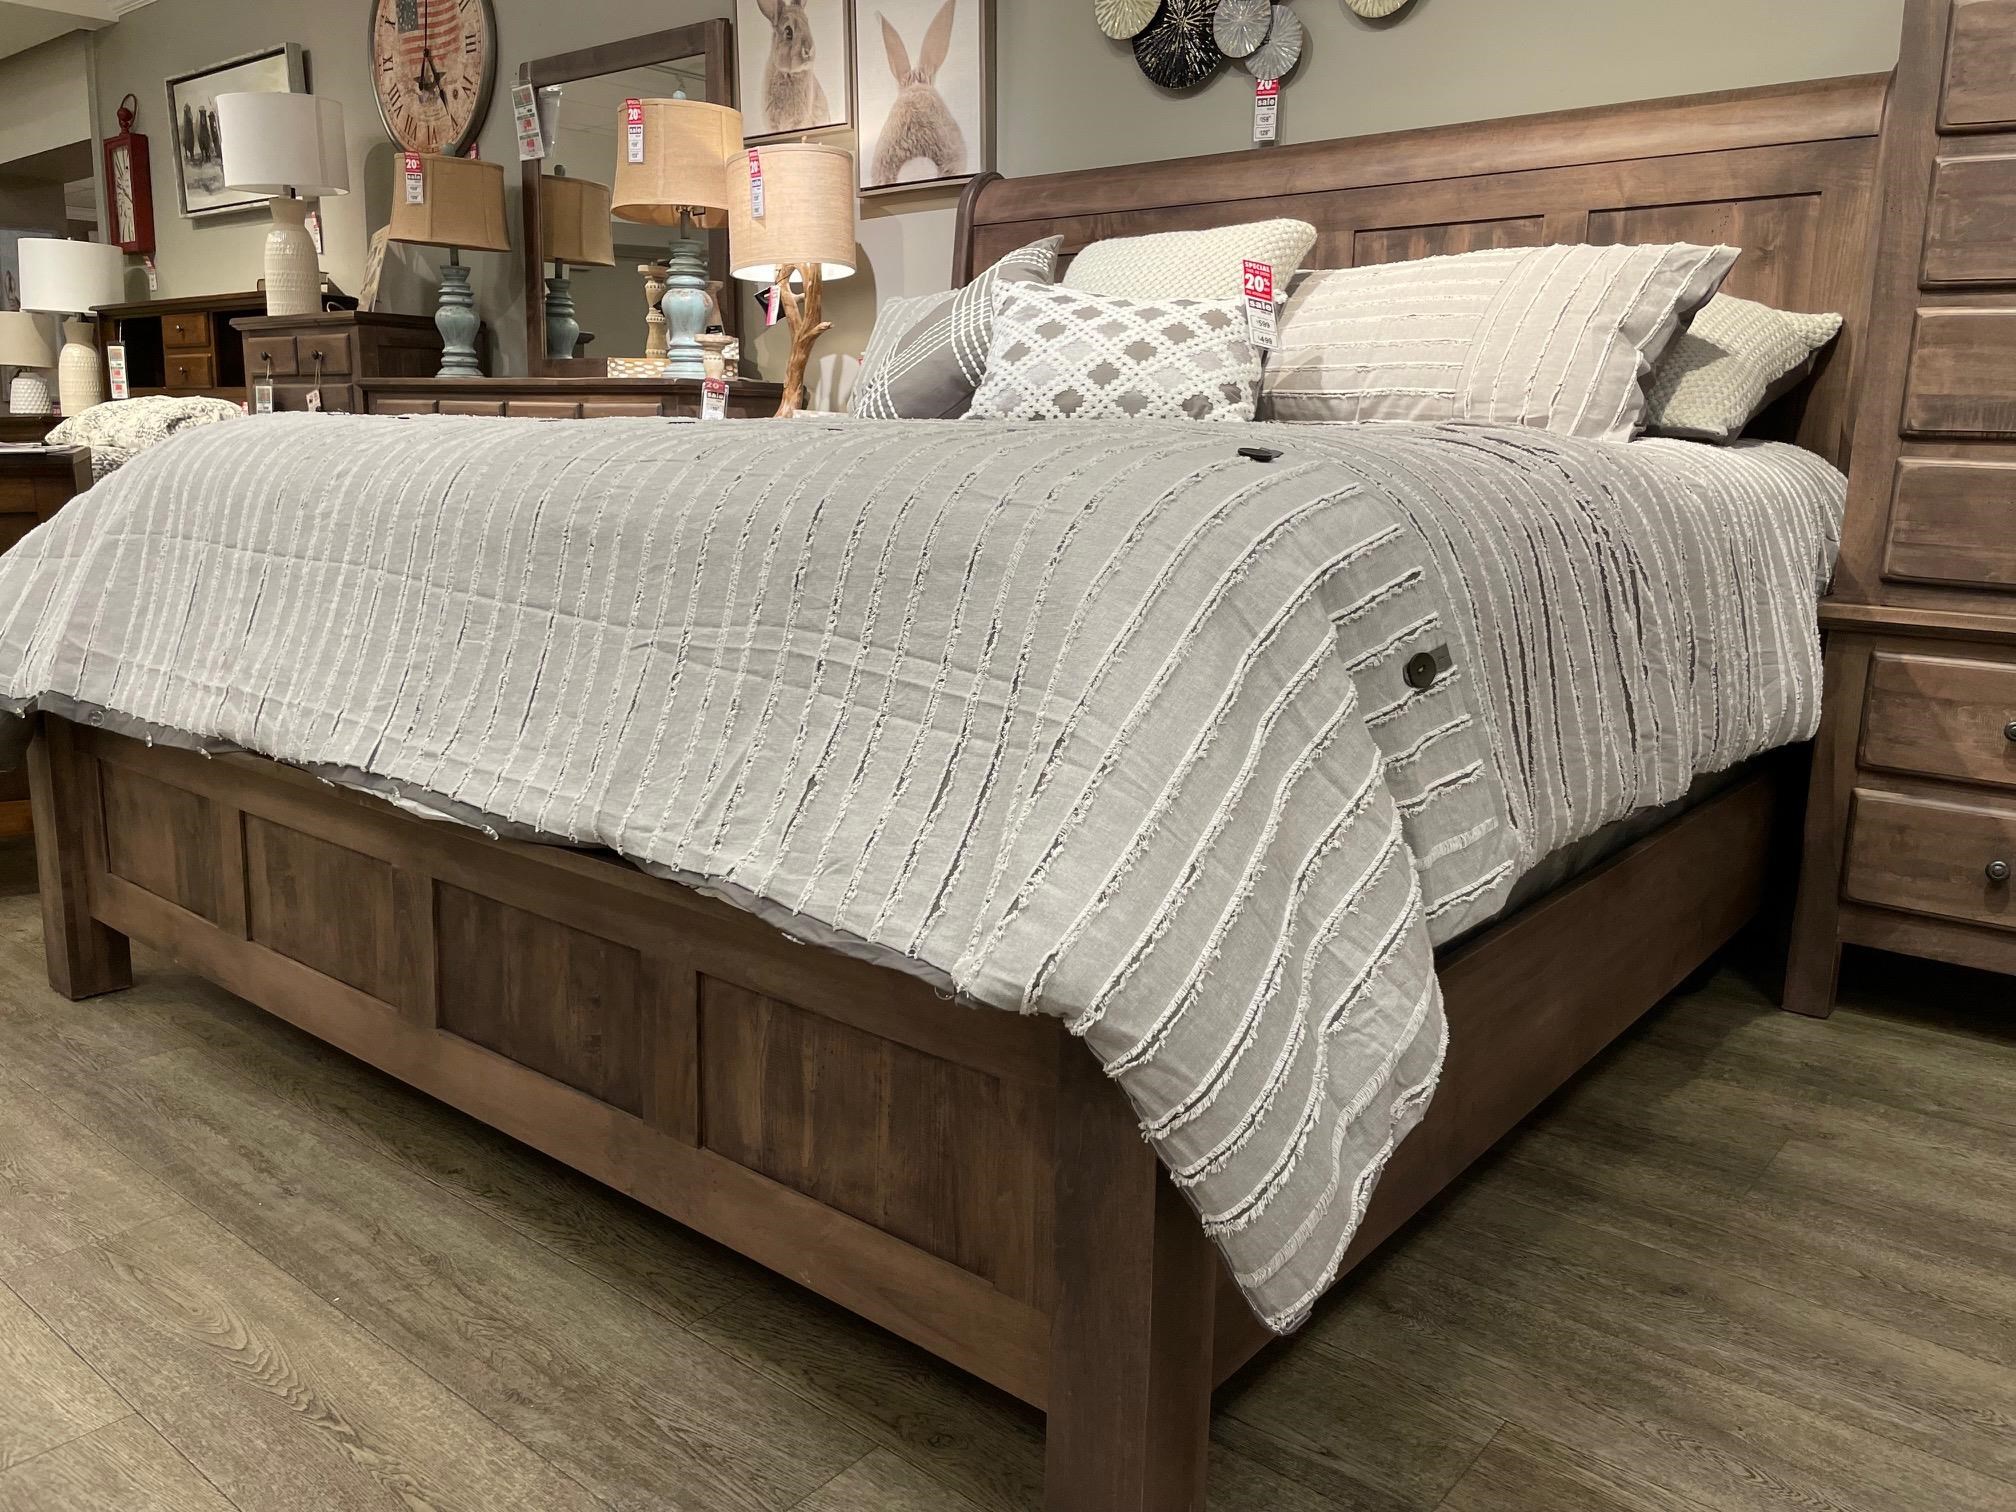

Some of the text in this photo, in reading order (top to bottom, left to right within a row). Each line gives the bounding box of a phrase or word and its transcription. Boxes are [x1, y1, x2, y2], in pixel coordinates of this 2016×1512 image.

[465, 33, 477, 54] III
[1257, 98, 1275, 106] sale
[1244, 261, 1271, 273] SPECIAL
[1249, 299, 1272, 312] sale
